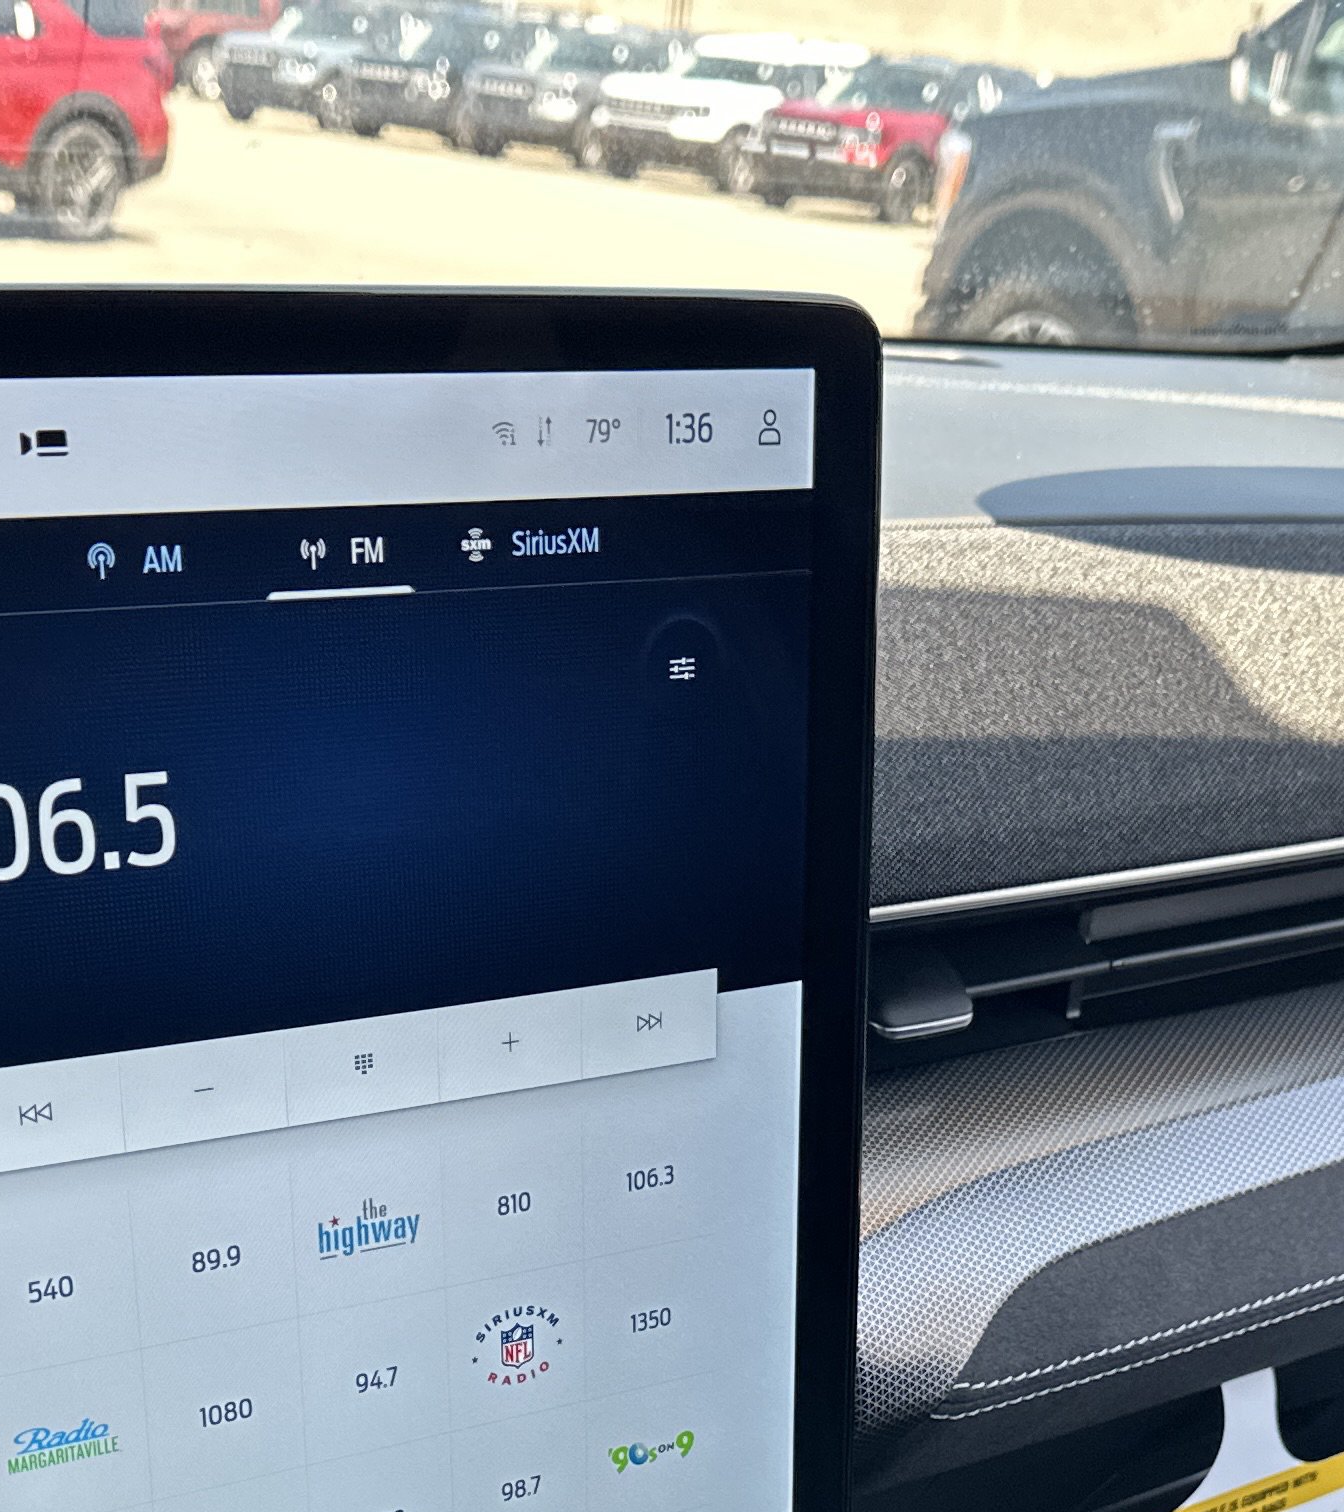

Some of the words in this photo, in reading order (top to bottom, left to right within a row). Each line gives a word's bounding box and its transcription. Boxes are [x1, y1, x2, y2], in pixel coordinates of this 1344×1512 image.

[666, 412, 713, 444] 1:36
[350, 536, 384, 565] FM
[511, 527, 600, 557] SiriusXM
[142, 545, 183, 574] AM
[626, 1165, 675, 1192] 106.3
[362, 1197, 388, 1221] the
[497, 1191, 531, 1216] 810
[318, 1213, 420, 1257] highway
[192, 1245, 241, 1273] 89.9
[28, 1275, 74, 1304] 540
[475, 1305, 560, 1343] SIRIUSXM
[630, 1307, 672, 1334] 1350
[504, 1340, 532, 1364] NFL
[355, 1366, 398, 1394] 94.7
[487, 1360, 550, 1387] RADIO
[199, 1398, 253, 1428] 1080
[13, 1418, 110, 1455] Radio
[7, 1435, 120, 1475] MARGARITAVILLE
[501, 1474, 542, 1502] 98.7
